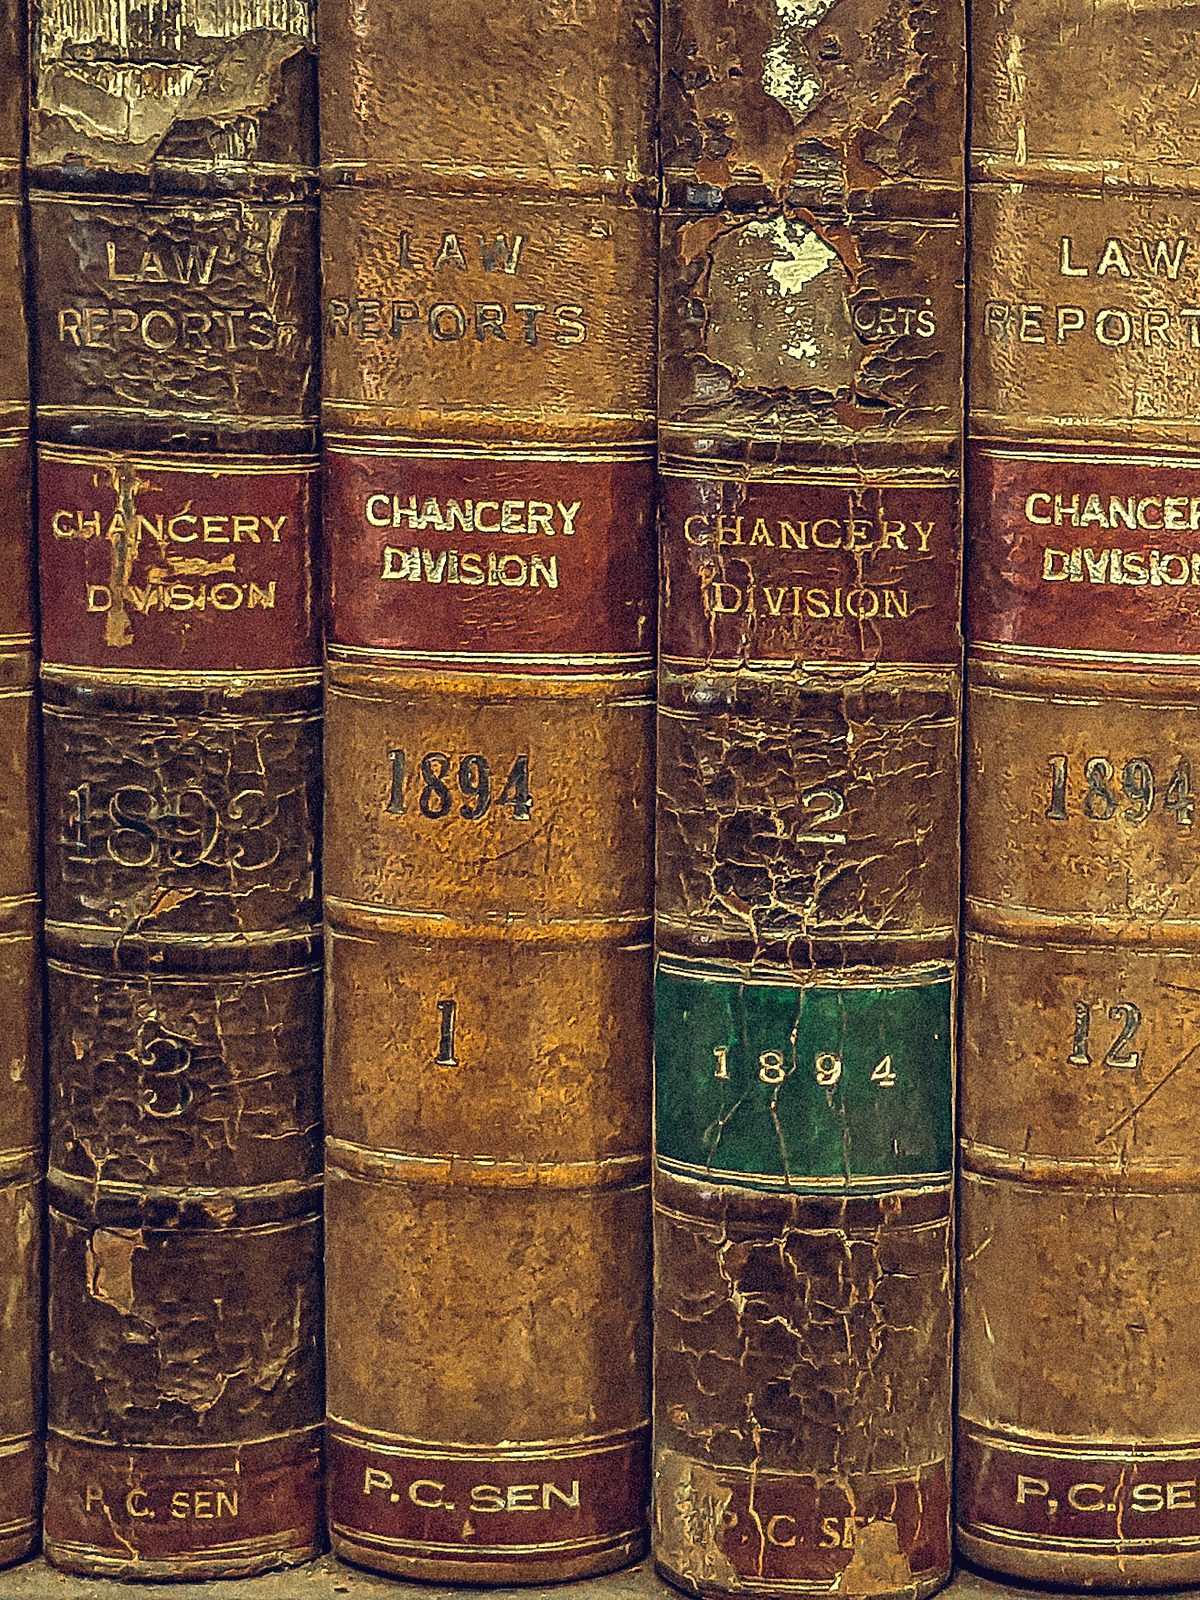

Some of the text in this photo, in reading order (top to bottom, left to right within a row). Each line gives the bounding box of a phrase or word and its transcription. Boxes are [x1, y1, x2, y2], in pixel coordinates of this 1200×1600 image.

[106, 240, 219, 285] LAW
[400, 232, 523, 276] LAW
[1060, 236, 1190, 281] LAW
[58, 306, 275, 351] REPORTS
[328, 298, 588, 347] REPORTS
[854, 305, 937, 339] ORTS
[52, 508, 289, 545] CHANCERY
[364, 493, 583, 538] CHANCERY
[684, 513, 937, 552] CHANCERY
[382, 545, 560, 589] DIVISION
[711, 582, 910, 620] DIVISION
[386, 748, 534, 822] 1894
[1045, 754, 1197, 826] 1894
[796, 788, 847, 846] 2
[434, 999, 459, 1068] 1
[1068, 1000, 1144, 1070] 12
[712, 1045, 897, 1088] 1894
[171, 1489, 239, 1519] SEN
[469, 1479, 582, 1514] SEN
